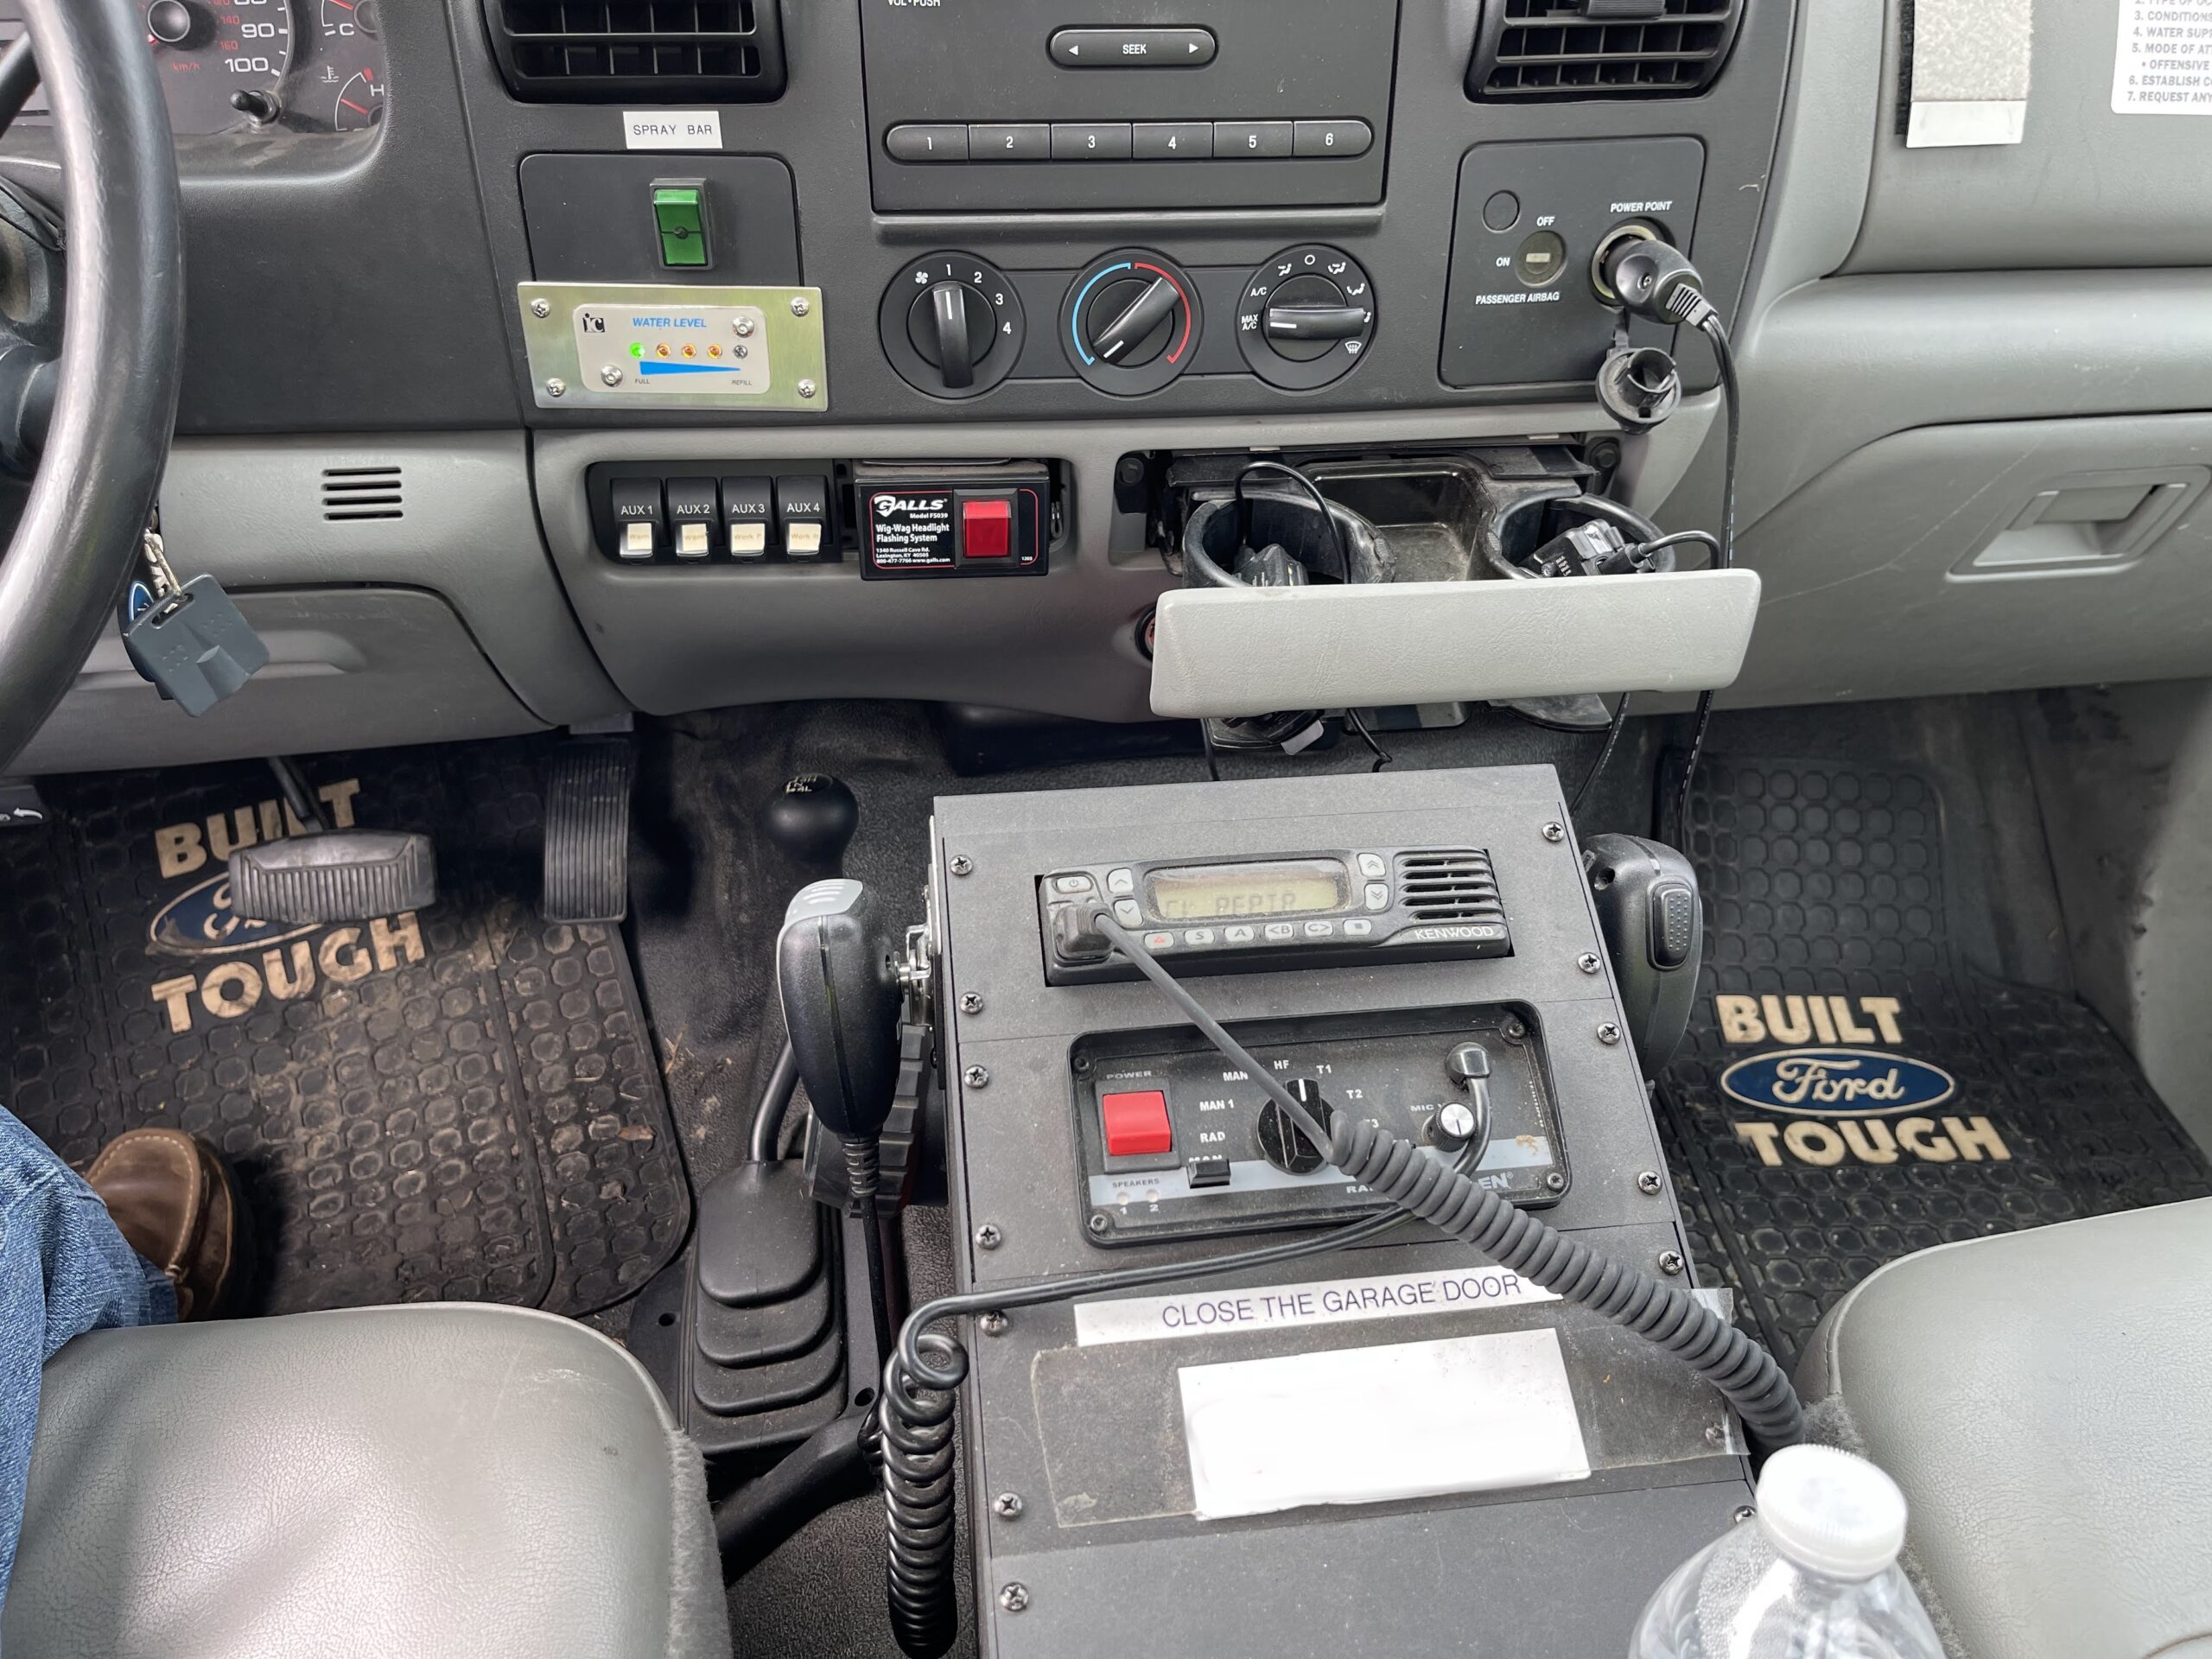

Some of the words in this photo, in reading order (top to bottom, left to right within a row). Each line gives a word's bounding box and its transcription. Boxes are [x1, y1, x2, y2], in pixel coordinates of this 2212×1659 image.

[2134, 10, 2144, 21] 3.
[241, 22, 275, 38] 90
[339, 23, 354, 36] C
[2133, 27, 2143, 37] 4.
[2146, 27, 2183, 38] WATER
[1122, 43, 1147, 55] SEEK
[2132, 42, 2141, 53] 5.
[2145, 43, 2177, 54] MODE
[2180, 44, 2196, 54] OF
[173, 62, 200, 71] km/h
[225, 57, 269, 73] 100
[2149, 60, 2209, 71] OFFENSIVE
[2128, 75, 2139, 86] 6.
[2142, 75, 2200, 86] ESTABLISH
[2127, 91, 2136, 102] 7.
[2139, 92, 2190, 104] REQUEST
[633, 124, 677, 136] SPRAY
[687, 124, 713, 136] BAR
[927, 137, 933, 150] 1
[1006, 136, 1014, 149] 2
[1088, 135, 1096, 149] 3
[1168, 137, 1177, 149] 4
[1249, 135, 1257, 149] 5
[1325, 133, 1333, 146] 6
[1610, 202, 1643, 213] POWER
[1644, 200, 1673, 212] POINT
[1536, 216, 1555, 227] OFF
[1496, 257, 1510, 267] ON
[946, 264, 951, 276] 1
[974, 271, 982, 283] 2
[1250, 287, 1268, 297] A/C
[1475, 293, 1526, 305] PASSENGER
[1527, 291, 1560, 303] AIRBAG
[995, 293, 1004, 306] 3
[632, 317, 671, 327] WATER
[674, 318, 707, 328] LEVEL
[1241, 314, 1258, 324] MAX
[1002, 321, 1012, 334] 4
[1242, 321, 1257, 331] A/C
[620, 505, 645, 516] AUX
[647, 505, 653, 515] 1
[677, 505, 702, 515] AUX
[702, 504, 710, 514] 2
[732, 504, 757, 514] AUX
[758, 503, 766, 513] 3
[787, 503, 811, 513] AUX
[812, 502, 820, 512] 4
[875, 524, 911, 534] Wig-Wag
[912, 523, 950, 533] Headlight
[876, 534, 909, 543] Flashing
[910, 534, 938, 543] System
[1415, 926, 1494, 939] KENWOOD
[151, 911, 425, 1033] TOUGH
[1716, 995, 1904, 1044] BUILT
[1274, 1060, 1289, 1070] HF
[1316, 1065, 1332, 1074] T1
[1106, 1071, 1152, 1079] POWER
[1223, 1071, 1249, 1081] MAN
[1772, 1058, 1905, 1103] Ford
[1346, 1089, 1363, 1099] T2
[1199, 1100, 1225, 1111] MAN
[1228, 1099, 1234, 1109] 1
[1410, 1103, 1434, 1112] MIC
[1363, 1118, 1379, 1128] 3
[1200, 1131, 1225, 1143] RAD
[1734, 1116, 2012, 1166] TOUGH
[1112, 1178, 1160, 1188] SPEAKERS
[1162, 1299, 1253, 1328] CLOSE
[1260, 1293, 1315, 1318] THE
[1322, 1281, 1434, 1313] GARAGE
[1442, 1274, 1522, 1301] DOOR
